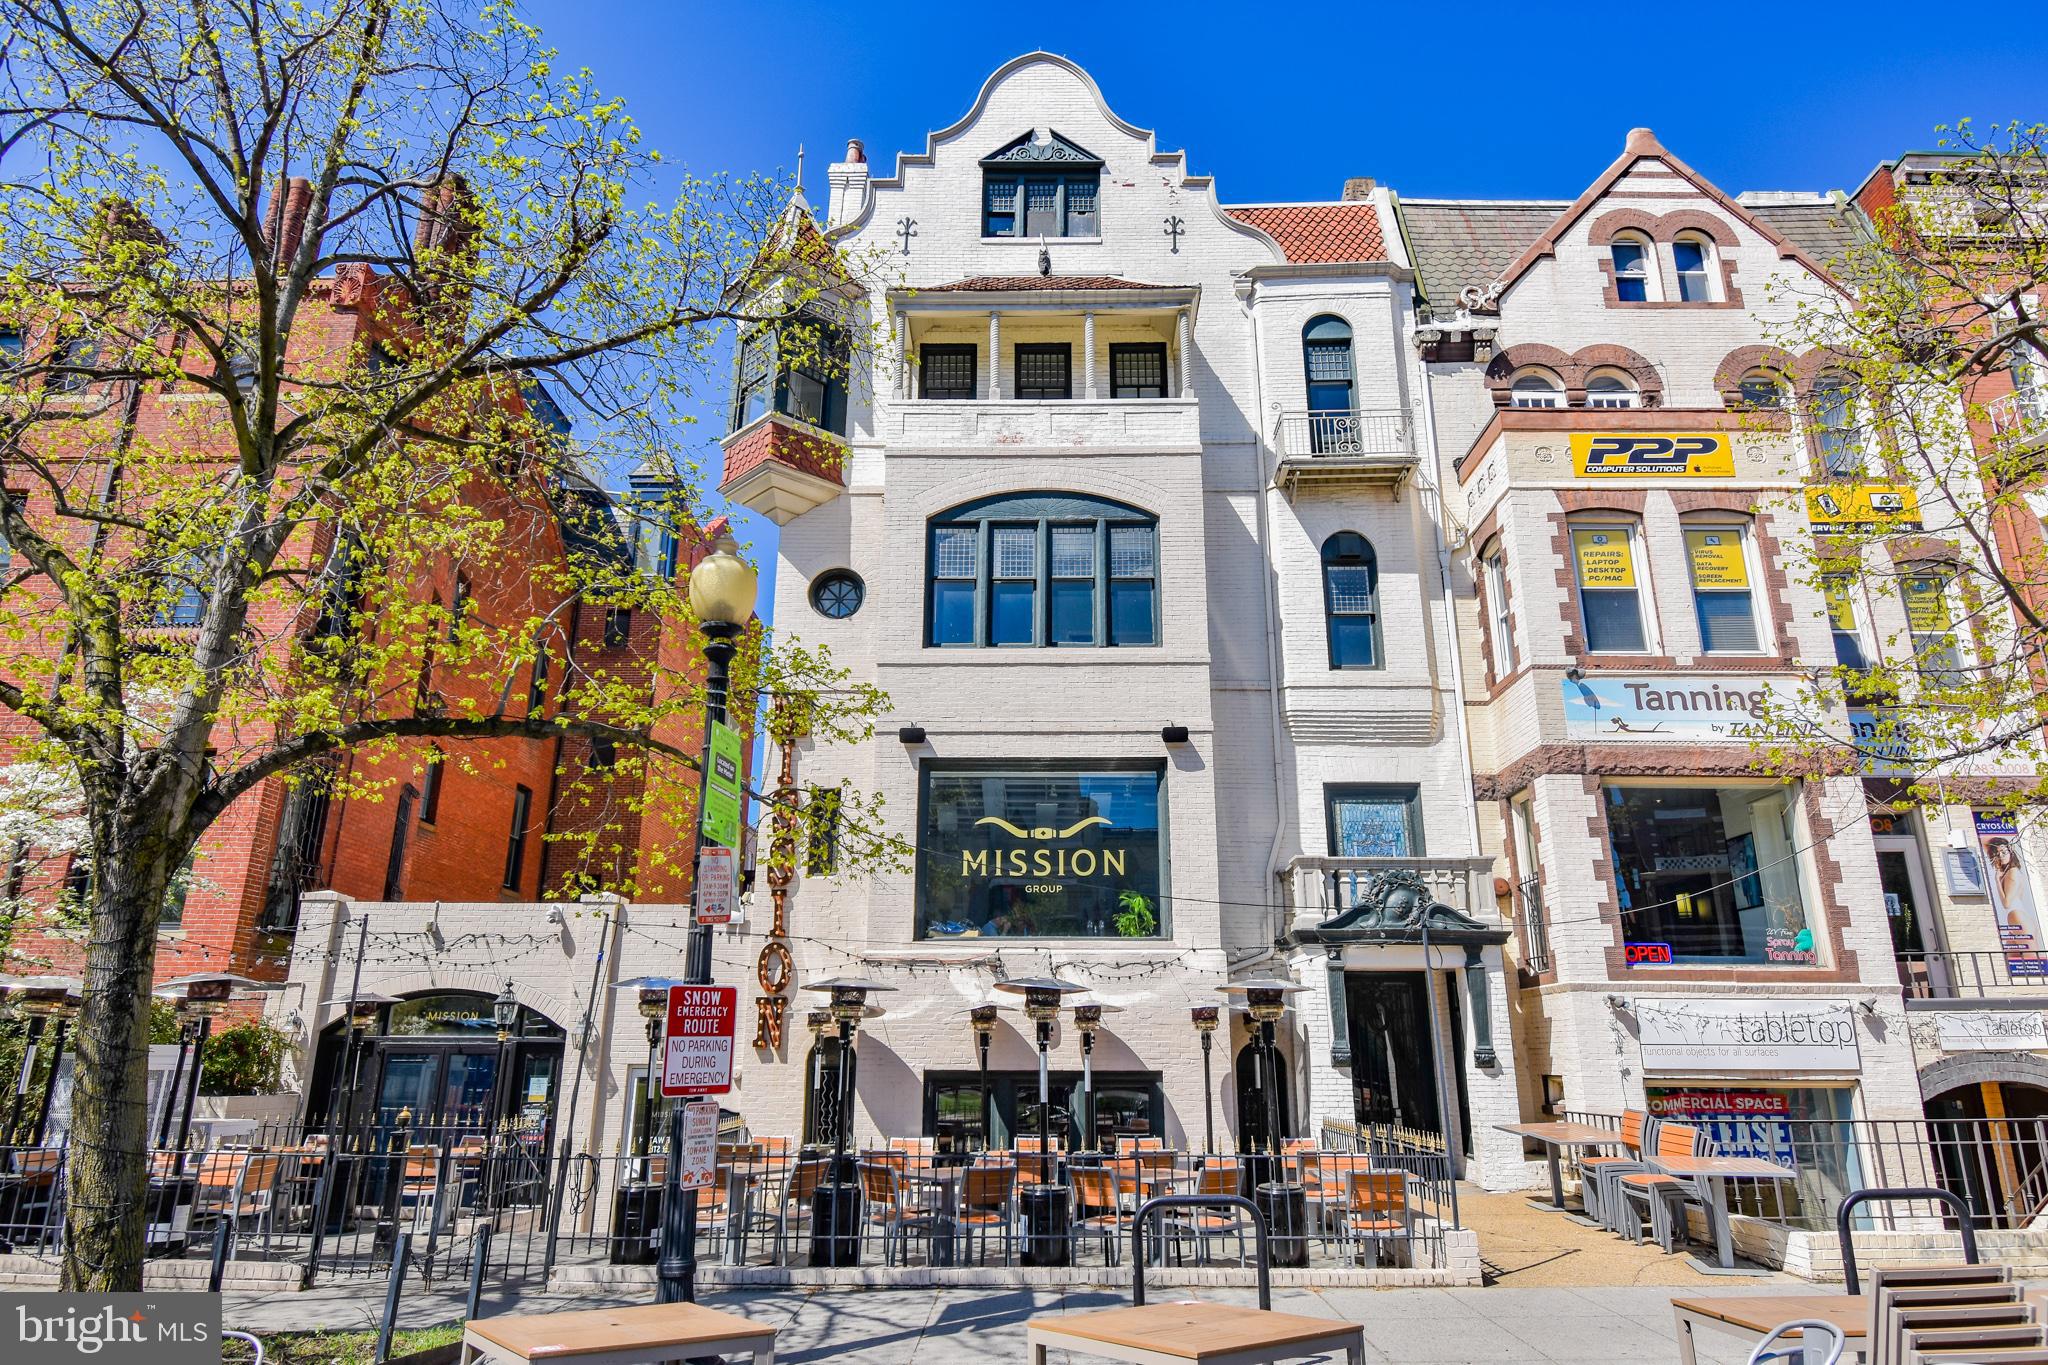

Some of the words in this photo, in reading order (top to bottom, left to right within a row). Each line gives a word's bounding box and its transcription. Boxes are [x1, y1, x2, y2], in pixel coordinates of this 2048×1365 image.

[1587, 437, 1718, 464] P2P
[1586, 465, 1635, 473] COMPUTER
[1623, 682, 1767, 719] Tanning
[1711, 724, 1724, 734] by
[1730, 722, 1768, 735] TAN
[961, 849, 1126, 877] MISSION
[1025, 884, 1063, 893] GROUP
[1766, 936, 1795, 948] Spray
[1625, 946, 1670, 962] OPEN
[1765, 947, 1817, 965] Tanning
[683, 990, 721, 1006] SNOW
[426, 1011, 479, 1021] MISSION
[677, 1006, 728, 1017] EMERGENCY
[683, 1019, 720, 1034] ROUTE
[1738, 1011, 1854, 1049] tabletop
[671, 1040, 686, 1053] NO
[688, 1039, 728, 1053] PARKING
[1644, 1047, 1683, 1057] functional
[1685, 1047, 1716, 1058] objects
[1718, 1047, 1730, 1057] for
[1732, 1047, 1742, 1057] all
[1744, 1047, 1779, 1057] surfaces
[681, 1055, 716, 1069] DURING
[670, 1071, 726, 1085] EMERGENCY
[1736, 1097, 1783, 1110] SPACE
[692, 1117, 711, 1127] SUNDAY
